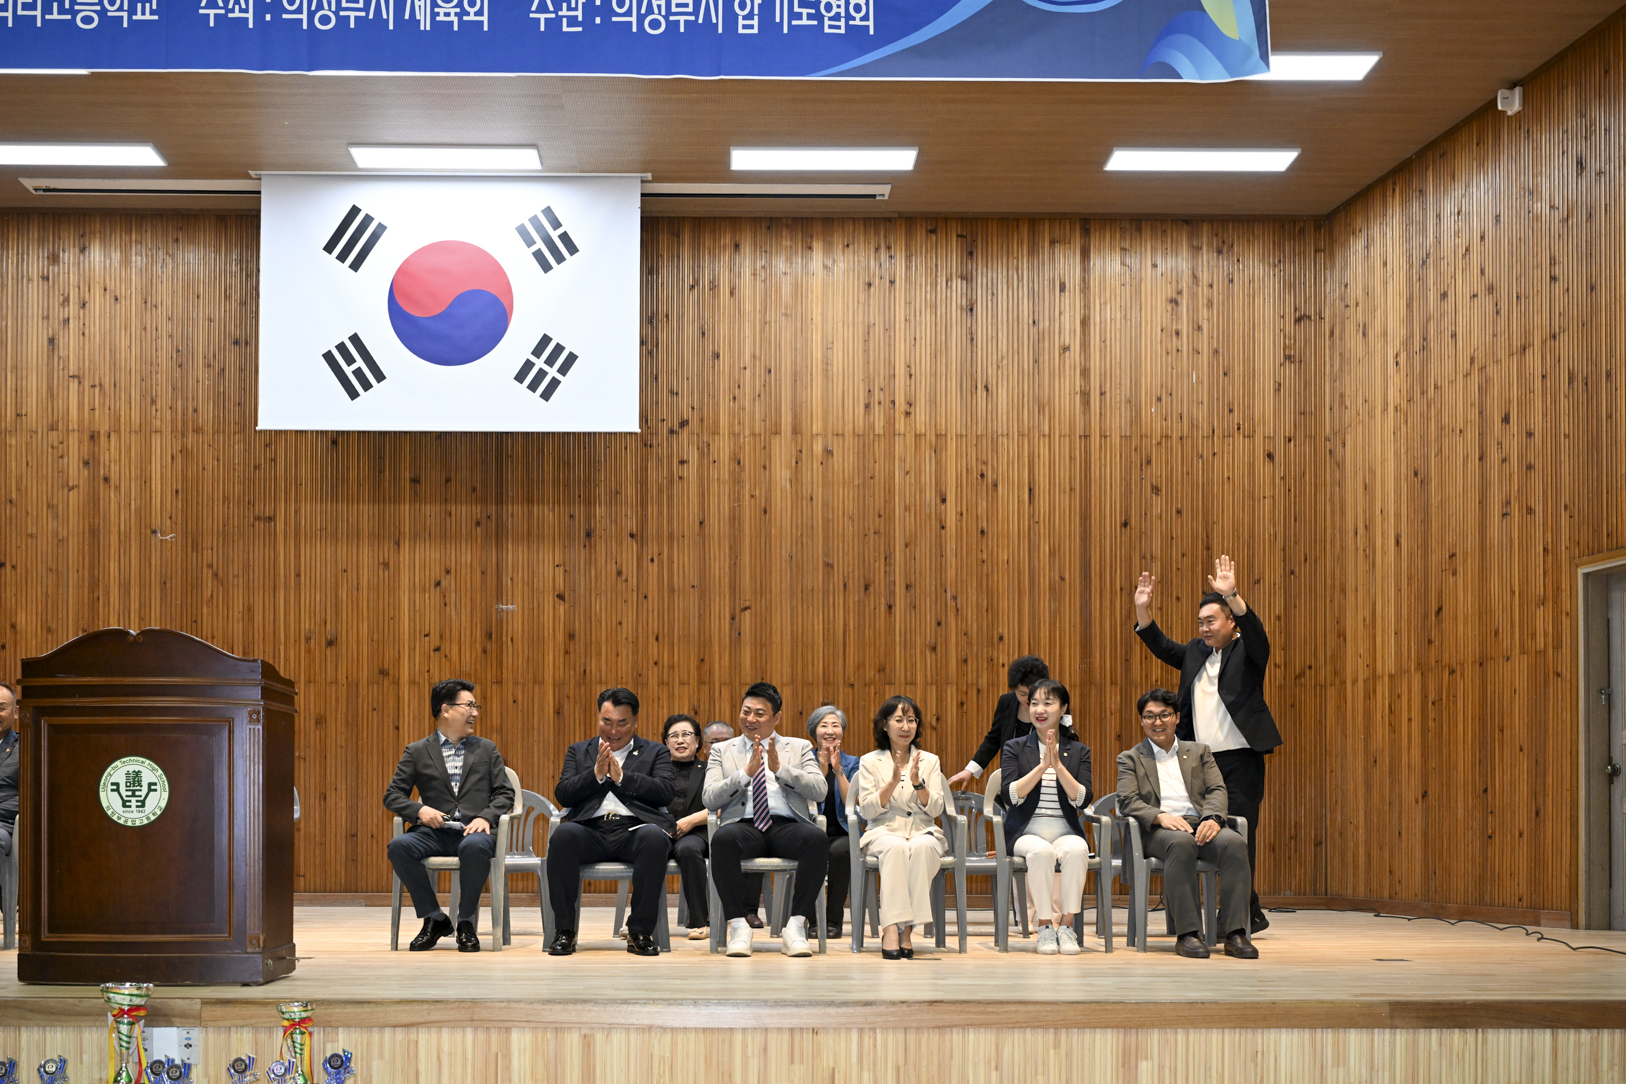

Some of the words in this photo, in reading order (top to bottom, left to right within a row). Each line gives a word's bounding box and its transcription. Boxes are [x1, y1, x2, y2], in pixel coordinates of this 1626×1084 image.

[282, 0, 394, 30] 의정부시
[611, 0, 723, 35] 의정부시
[147, 763, 159, 773] High
[158, 773, 167, 792] School
